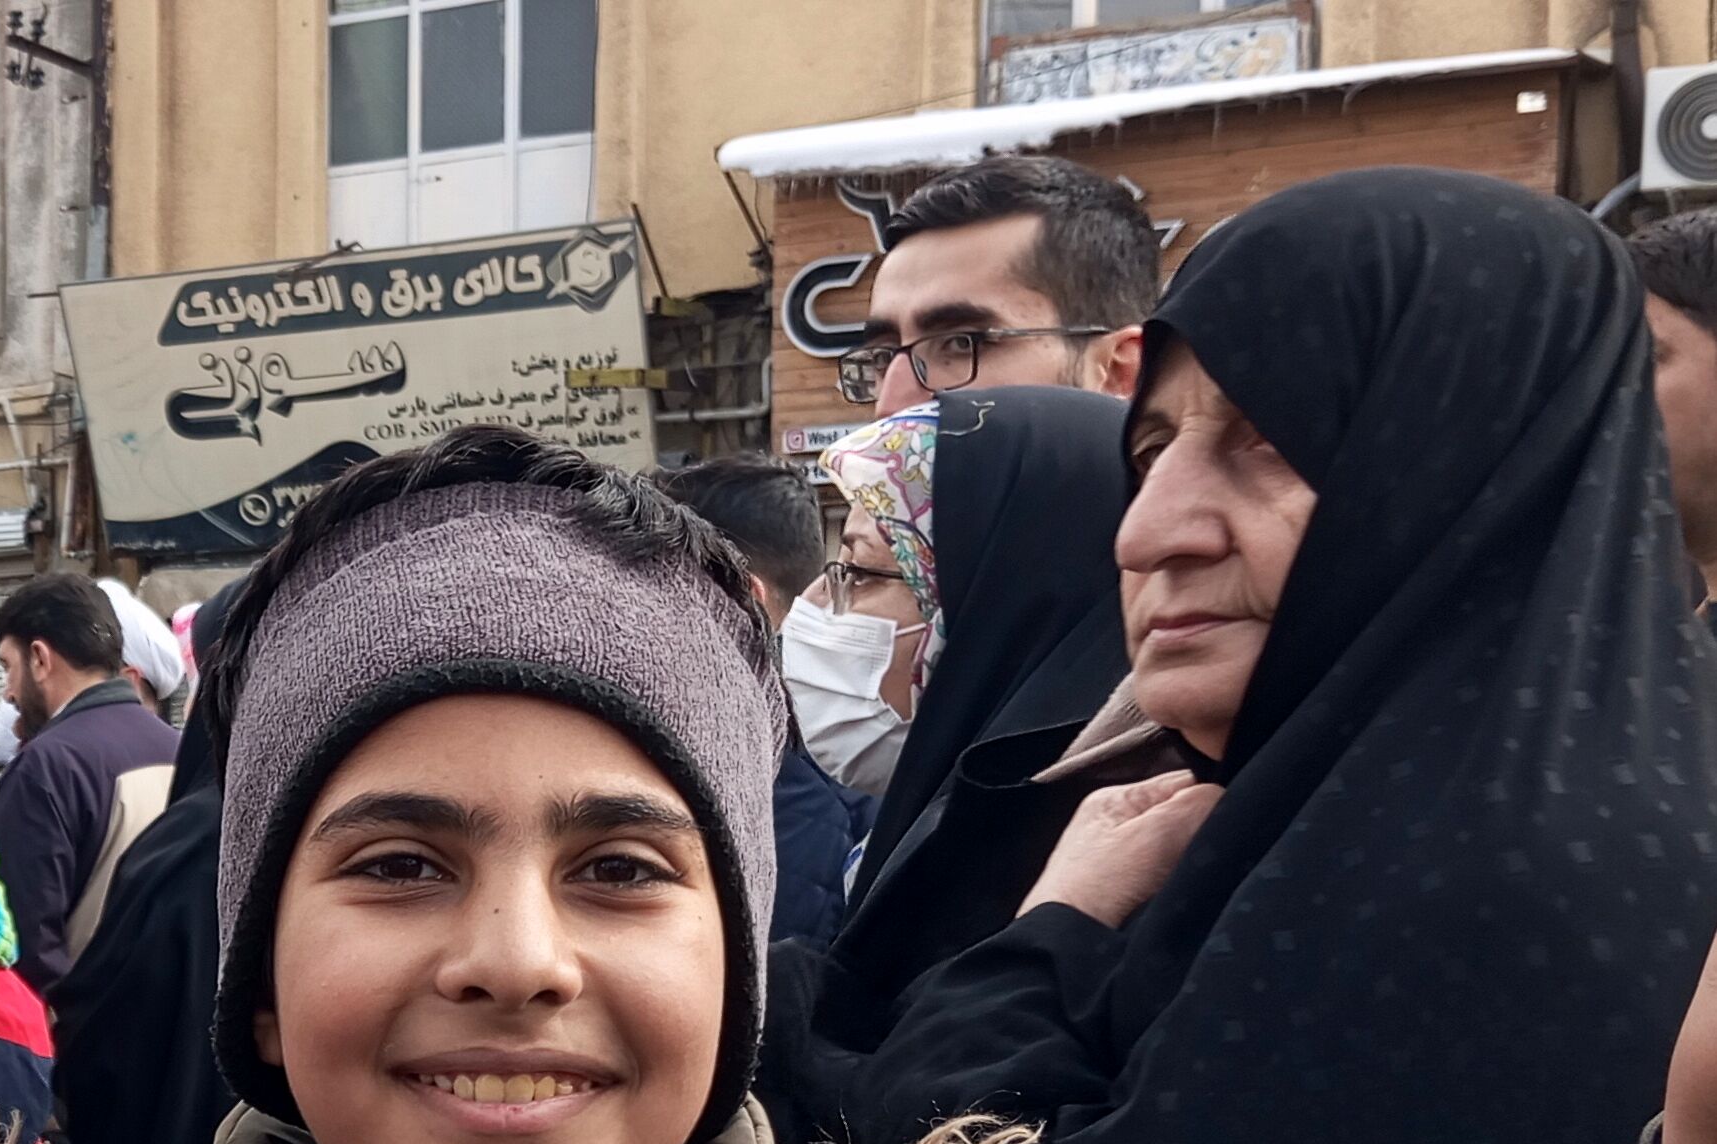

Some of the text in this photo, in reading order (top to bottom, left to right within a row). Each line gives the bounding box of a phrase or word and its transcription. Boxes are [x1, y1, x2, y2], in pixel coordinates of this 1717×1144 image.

[176, 253, 545, 333] کالای برق و الکترونیک
[489, 387, 536, 410] مصرف
